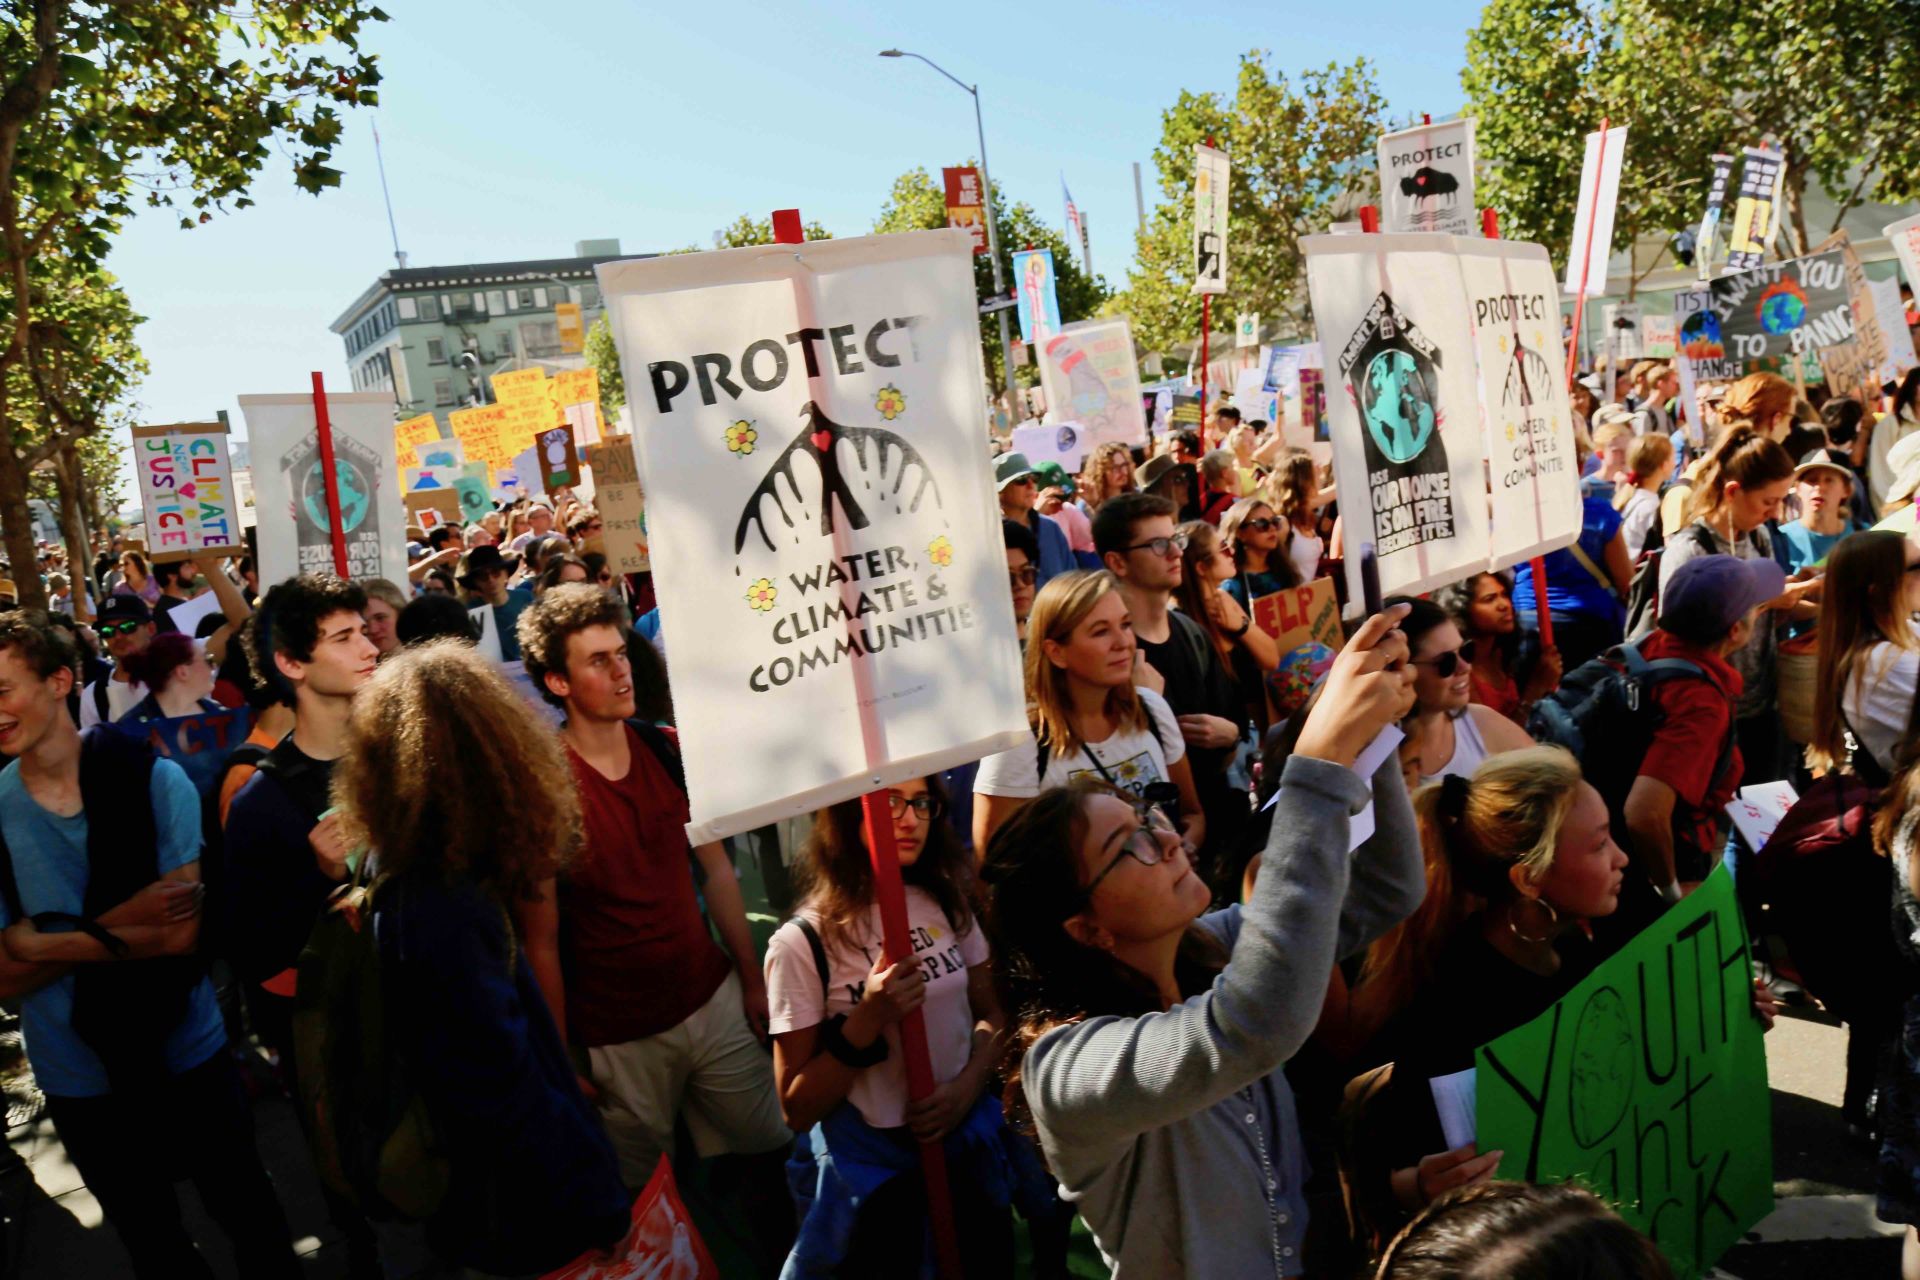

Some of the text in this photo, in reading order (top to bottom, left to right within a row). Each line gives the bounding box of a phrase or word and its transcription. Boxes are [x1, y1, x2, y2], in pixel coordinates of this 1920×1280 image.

[1392, 143, 1461, 167] PROTECT
[1721, 263, 1786, 308] WANT
[1796, 257, 1844, 290] YOU
[1476, 295, 1545, 327] PROTECT
[1731, 333, 1767, 359] TO
[1790, 305, 1855, 355] PANIC
[648, 315, 929, 414] PROTECT
[1690, 360, 1742, 379] HANGE
[146, 439, 188, 546] JUSTICE
[189, 439, 230, 547] CLIMATE
[1372, 472, 1450, 513] OUR HOUSE
[1376, 511, 1392, 539] IS
[1391, 503, 1415, 532] ON
[788, 546, 918, 597] WATER,
[772, 573, 949, 645] CLIMATE &
[1483, 889, 1758, 1183] YOUTH
